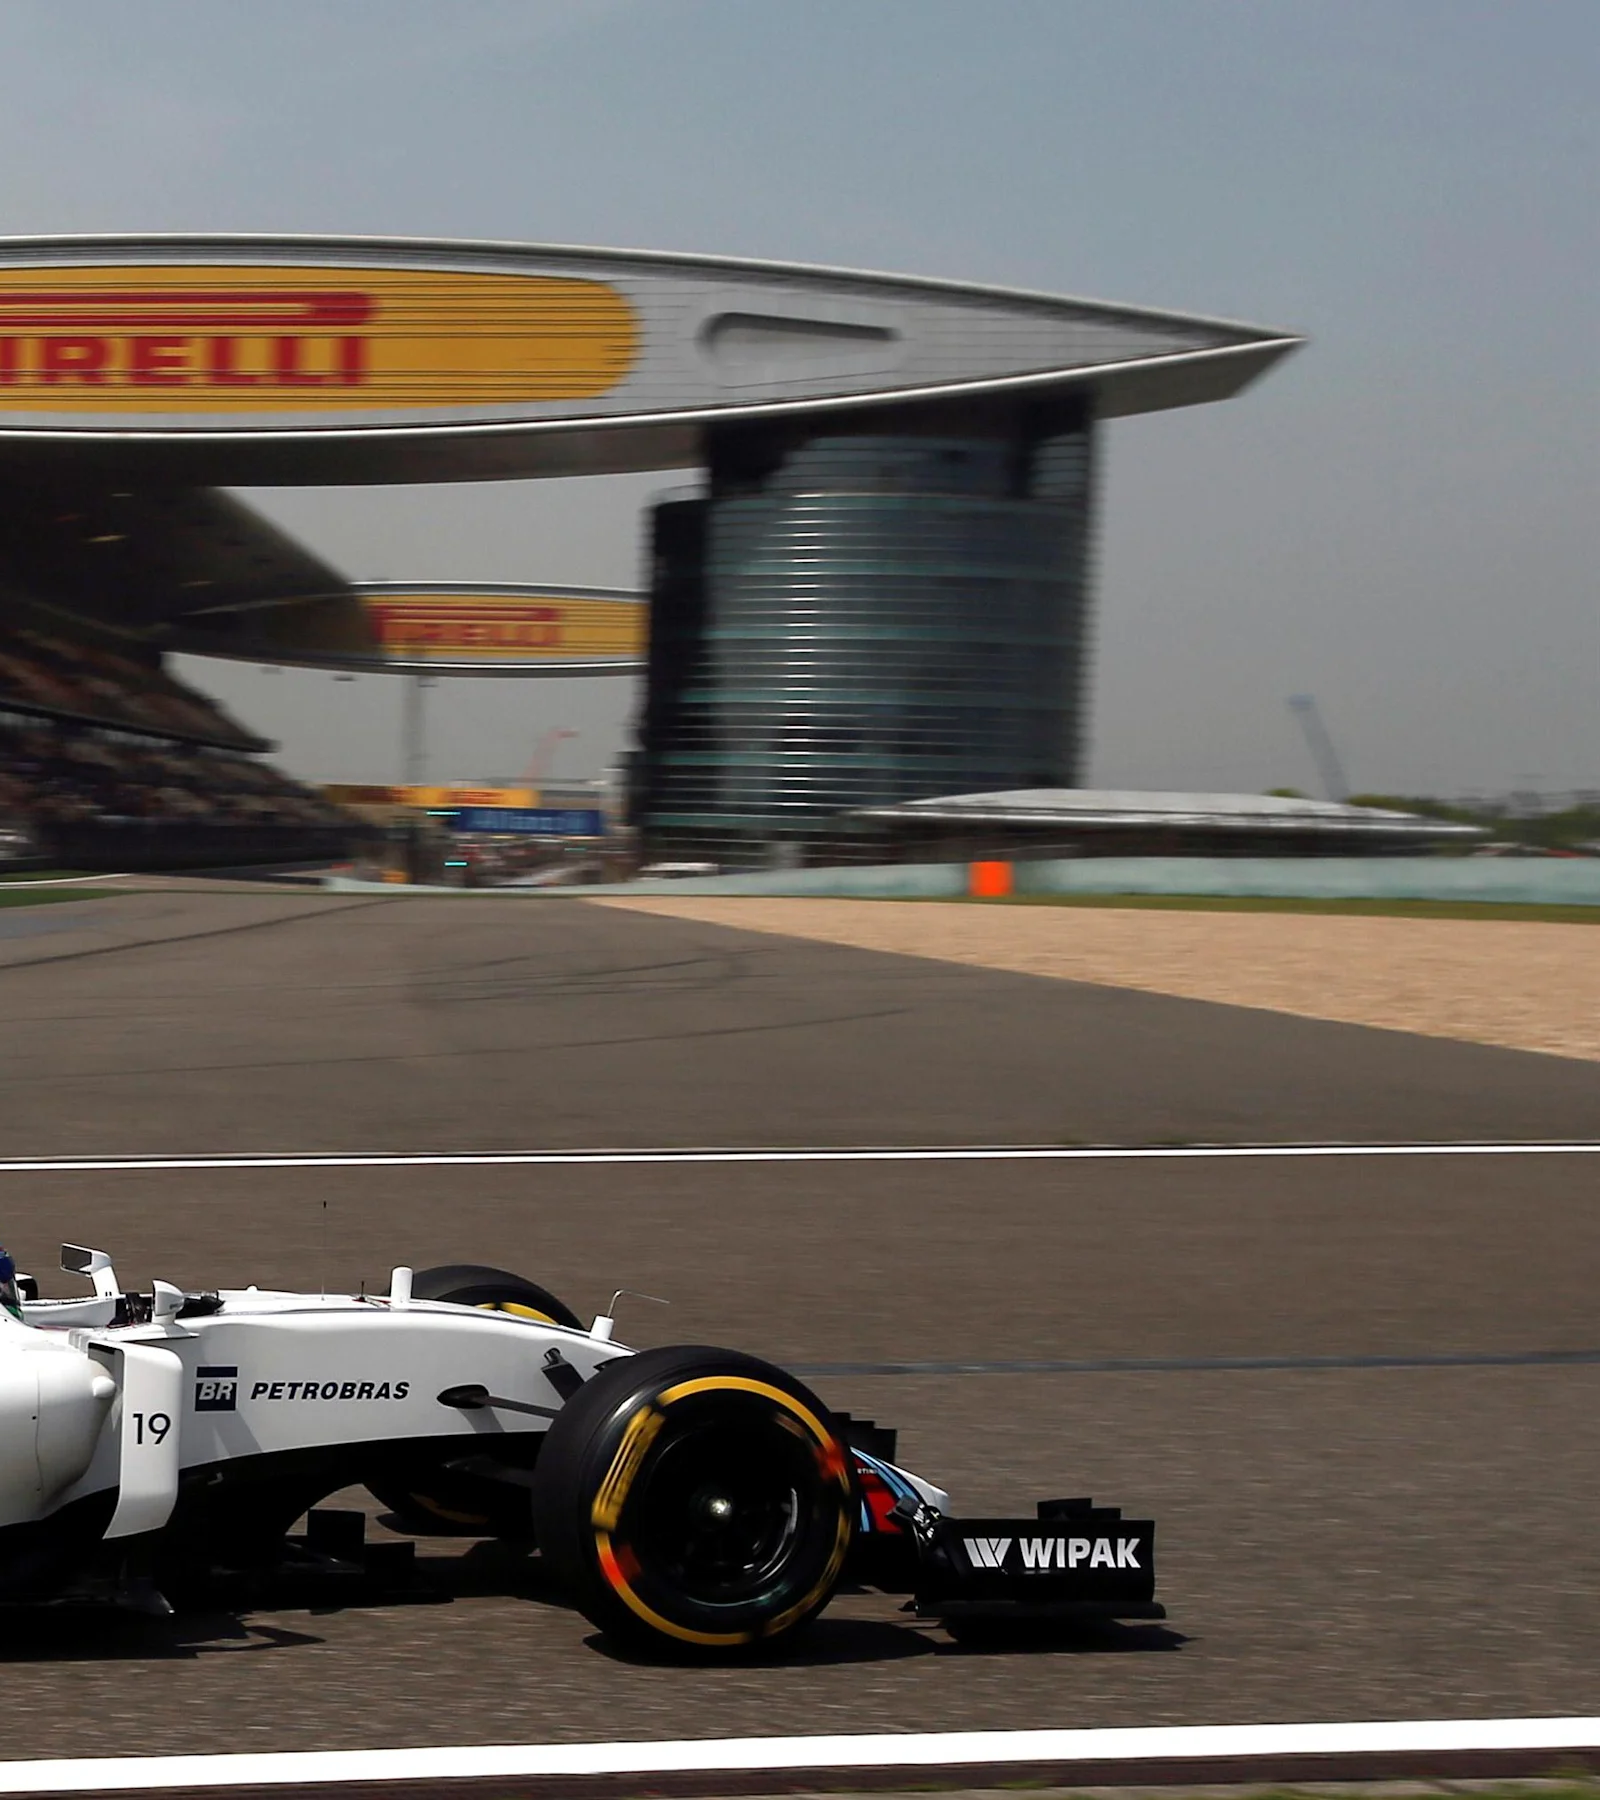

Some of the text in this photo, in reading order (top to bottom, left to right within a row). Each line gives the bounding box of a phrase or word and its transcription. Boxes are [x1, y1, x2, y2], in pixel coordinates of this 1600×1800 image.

[199, 1382, 233, 1400] BR
[250, 1381, 410, 1400] PETROBRAS
[132, 1413, 171, 1445] 19
[1019, 1538, 1142, 1568] WIPAK
